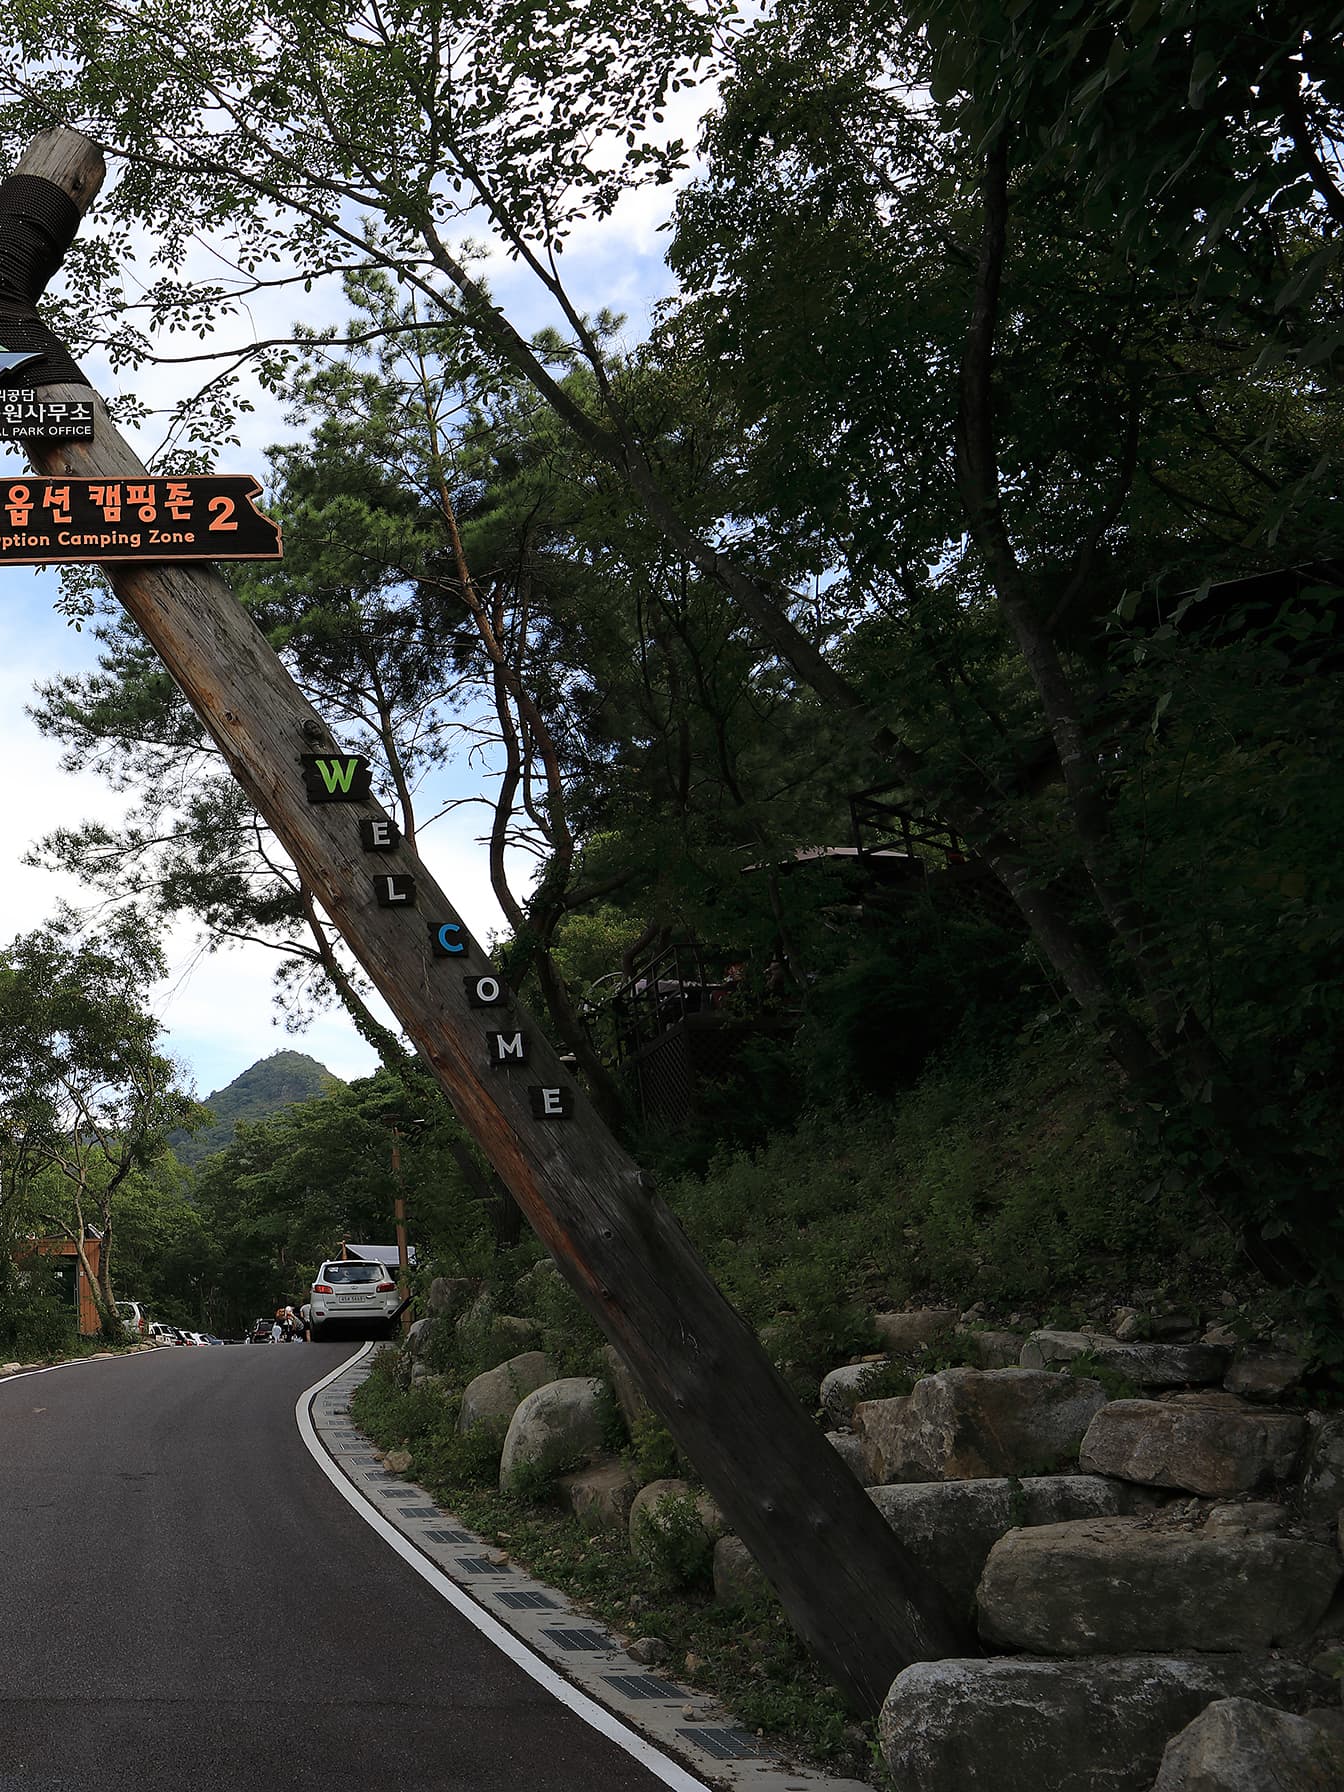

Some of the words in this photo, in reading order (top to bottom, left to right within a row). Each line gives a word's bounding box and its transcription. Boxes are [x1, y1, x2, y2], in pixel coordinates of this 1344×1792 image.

[12, 426, 45, 436] PARK
[48, 425, 92, 436] OFFICE
[88, 482, 194, 523] 캠핑존
[207, 496, 239, 531] 2
[57, 530, 142, 548] Camping
[148, 530, 195, 544] Zone
